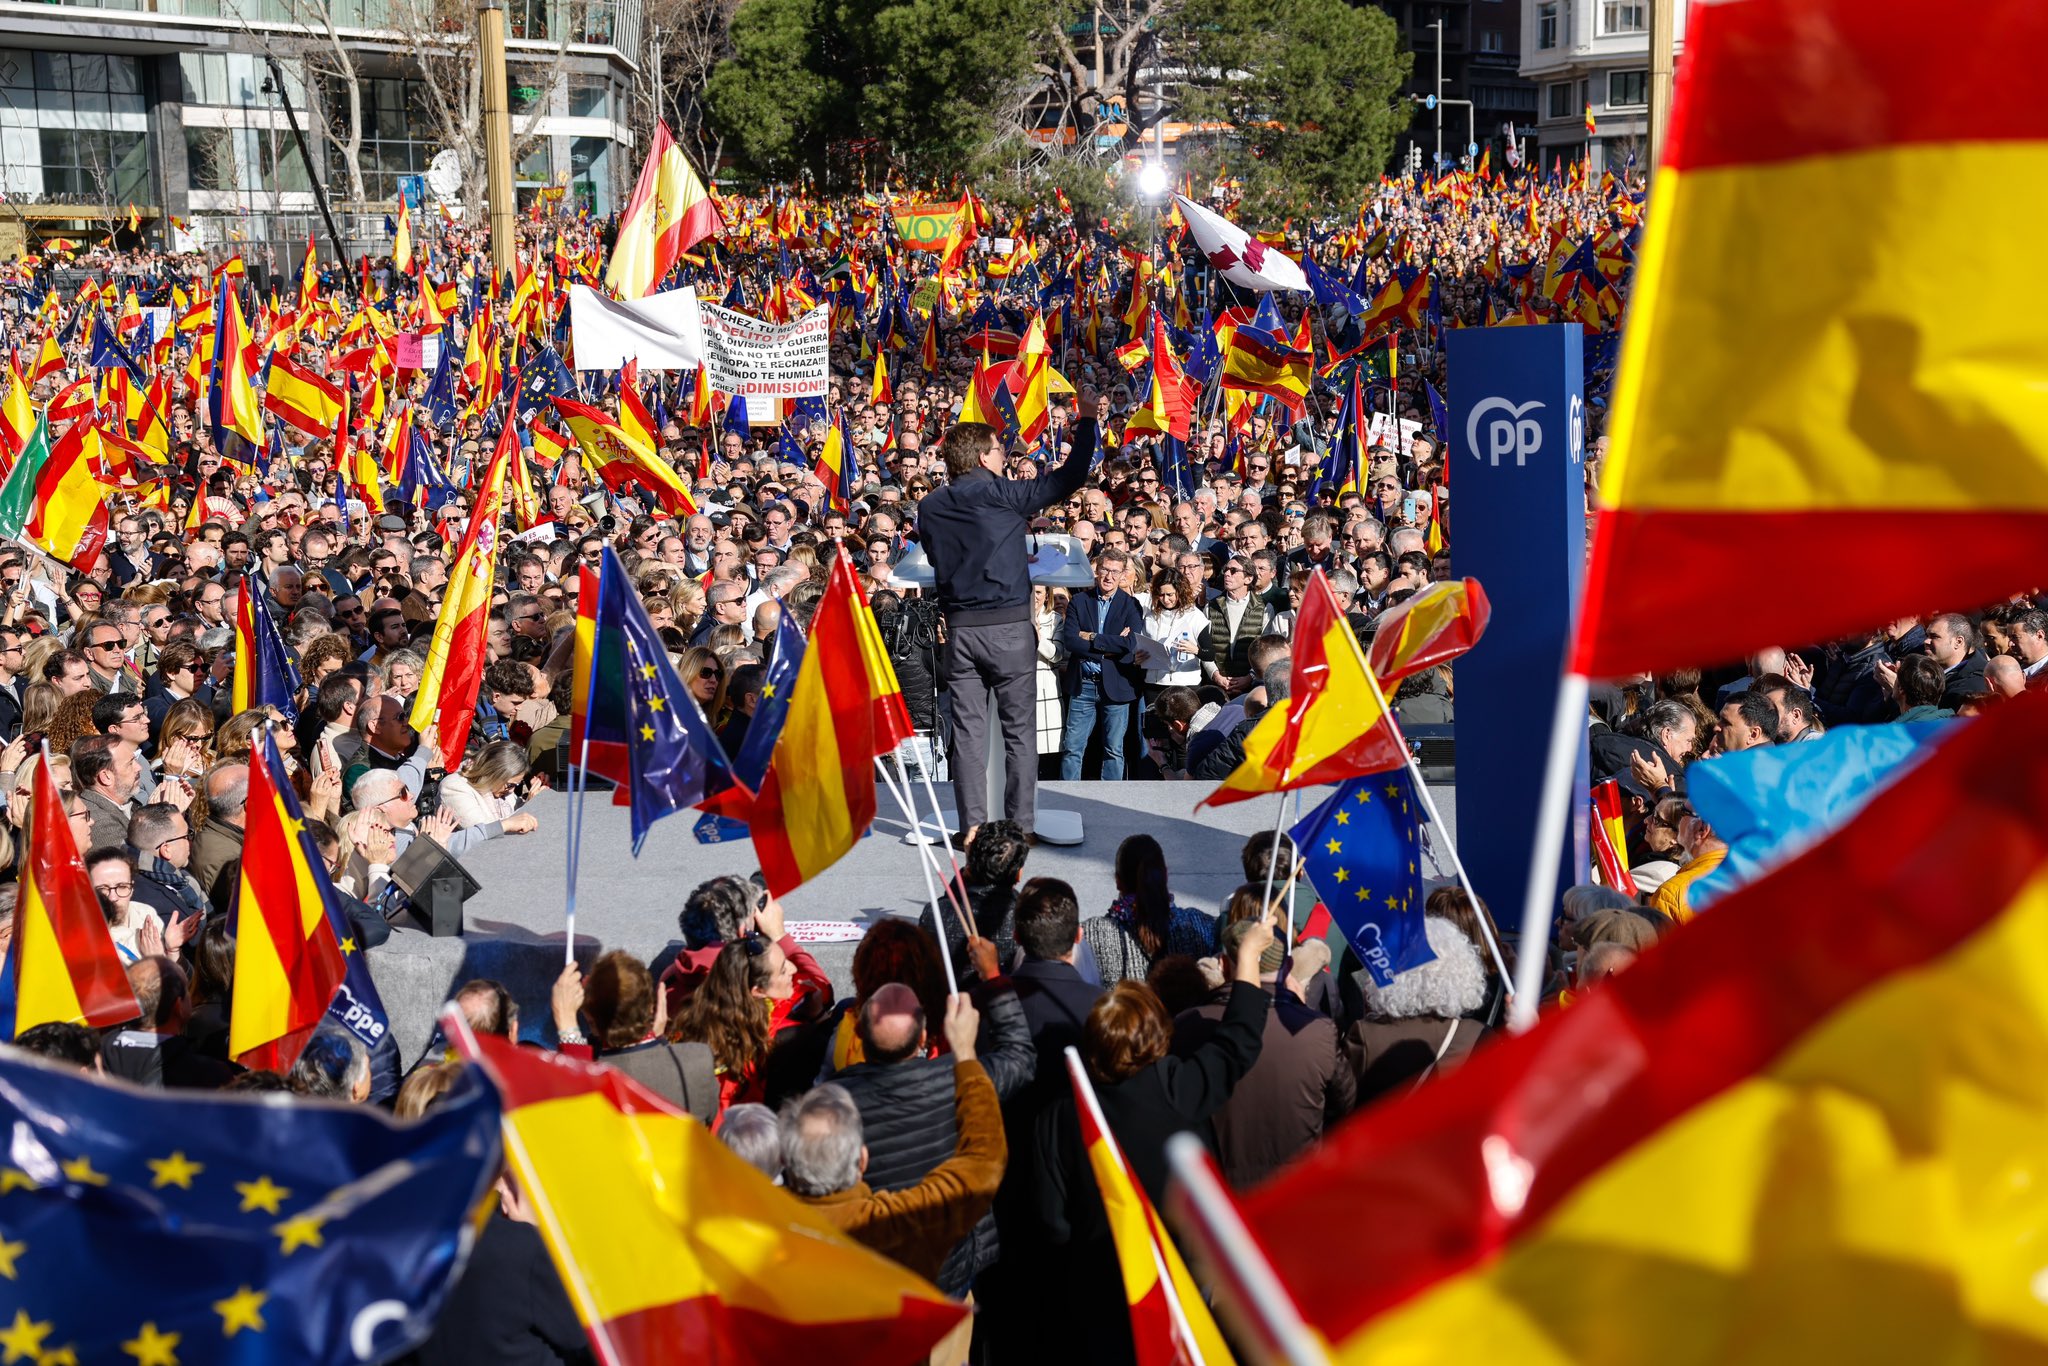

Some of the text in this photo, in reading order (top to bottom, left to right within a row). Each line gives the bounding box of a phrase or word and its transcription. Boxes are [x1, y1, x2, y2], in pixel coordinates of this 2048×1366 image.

[897, 214, 956, 243] VOX
[722, 323, 772, 343] DELITO
[795, 319, 827, 335] ODIO
[759, 324, 774, 334] TU
[788, 333, 828, 347] GUERRA
[766, 351, 780, 359] TE
[784, 344, 828, 357] QUIERE!!!
[770, 356, 826, 368] RECHAZA!!!
[719, 366, 757, 380] MUNDO
[778, 369, 823, 379] HUMILLA
[736, 379, 826, 395] ¡¡DIMISIÓN!!
[1365, 946, 1395, 980] ppe
[343, 1005, 384, 1038] ppe
